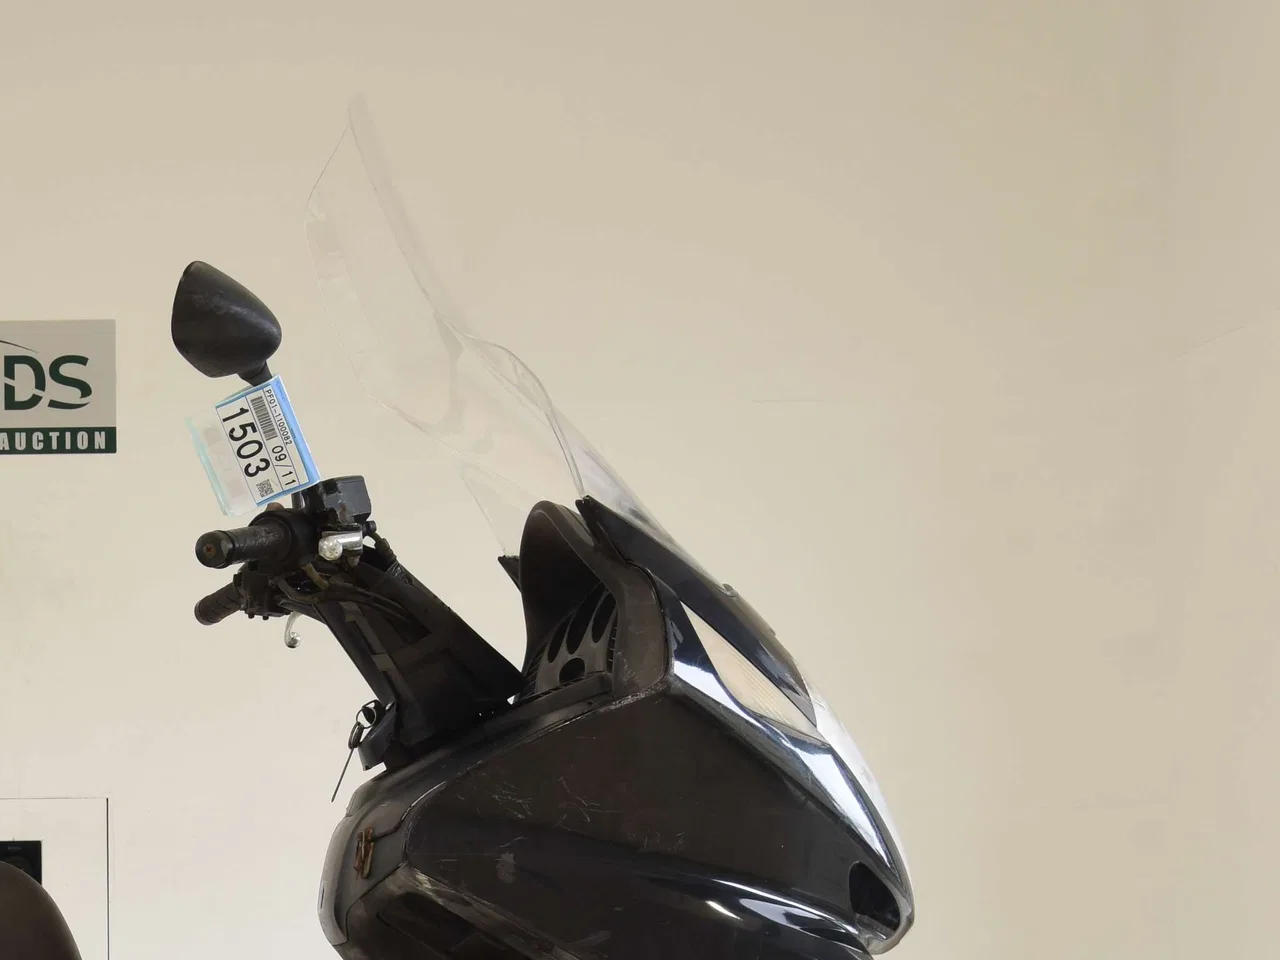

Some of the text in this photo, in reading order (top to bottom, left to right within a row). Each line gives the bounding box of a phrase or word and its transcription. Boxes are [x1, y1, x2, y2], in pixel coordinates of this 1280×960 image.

[222, 407, 271, 478] 1503
[266, 389, 293, 445] PF01-1100082
[272, 445, 296, 486] 09/11
